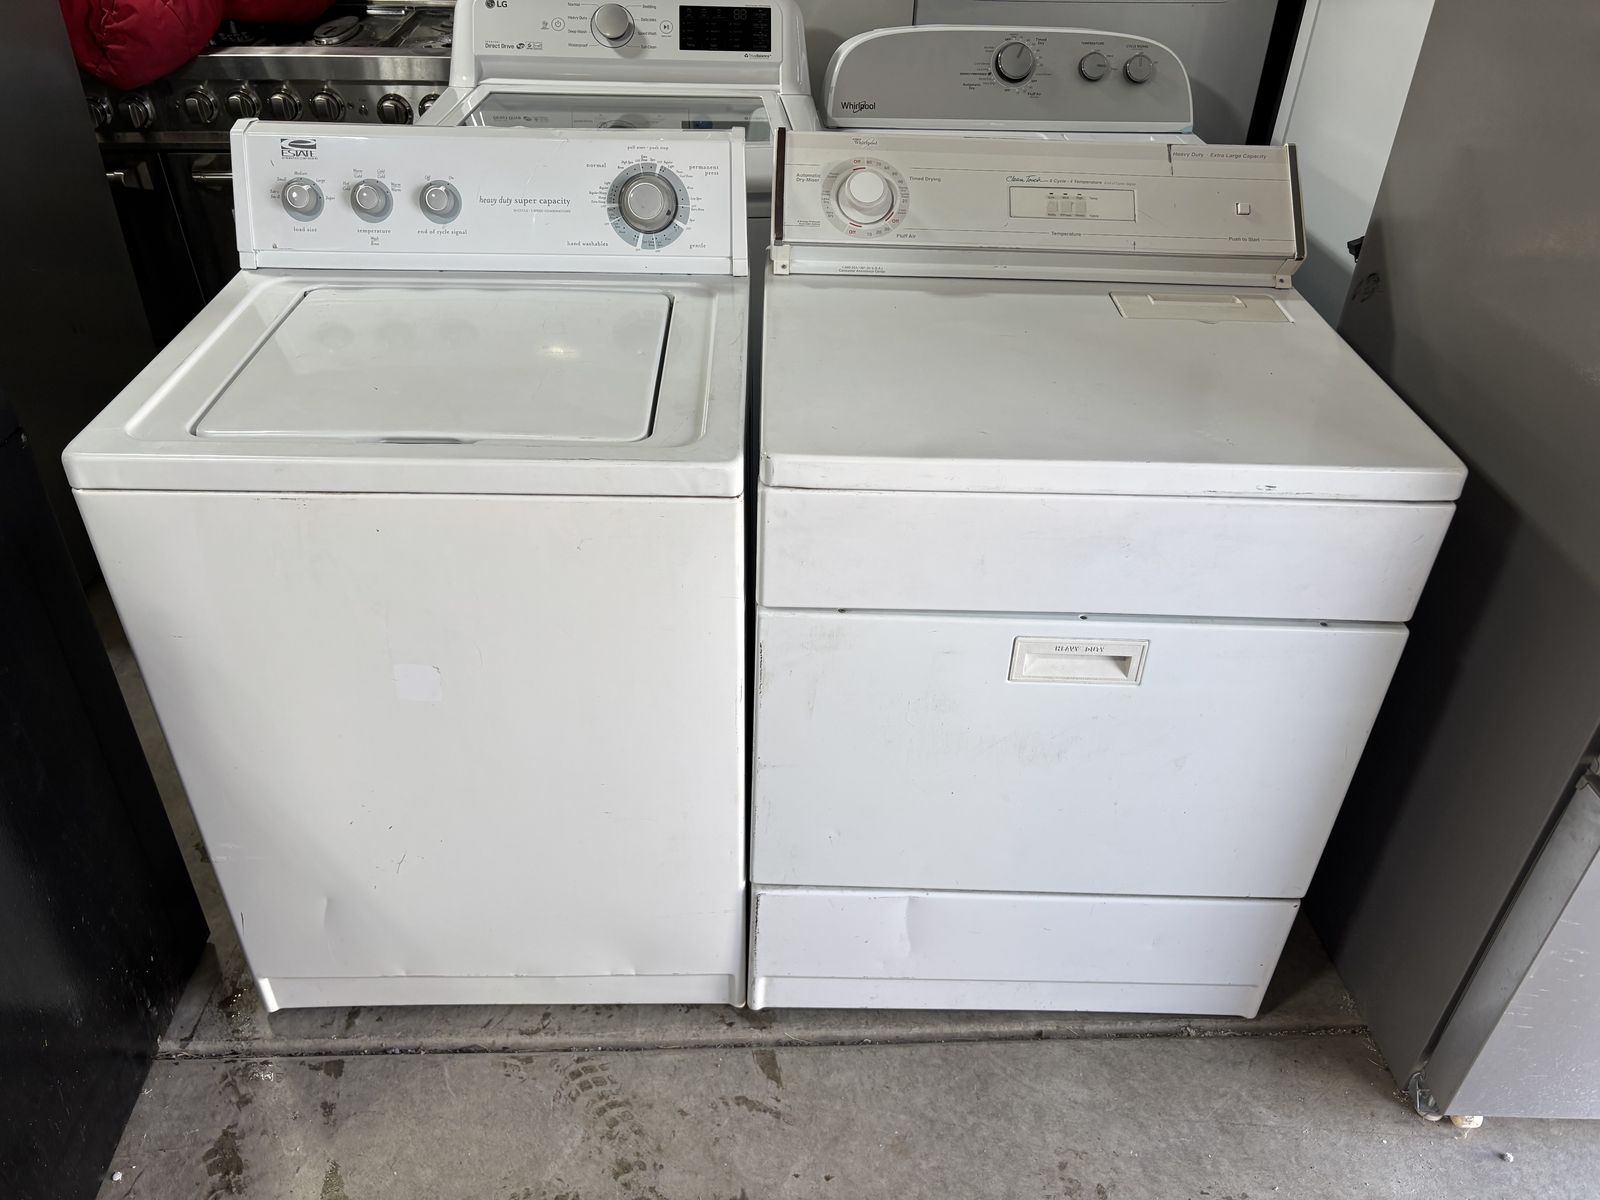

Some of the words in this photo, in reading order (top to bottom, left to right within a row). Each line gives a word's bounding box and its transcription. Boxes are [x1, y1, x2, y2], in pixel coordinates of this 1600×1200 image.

[841, 101, 876, 113] Whirlpool
[1025, 175, 1041, 183] Touch
[480, 195, 497, 206] heavy
[498, 196, 512, 206] duty
[514, 198, 537, 206] super
[539, 197, 571, 207] capacity
